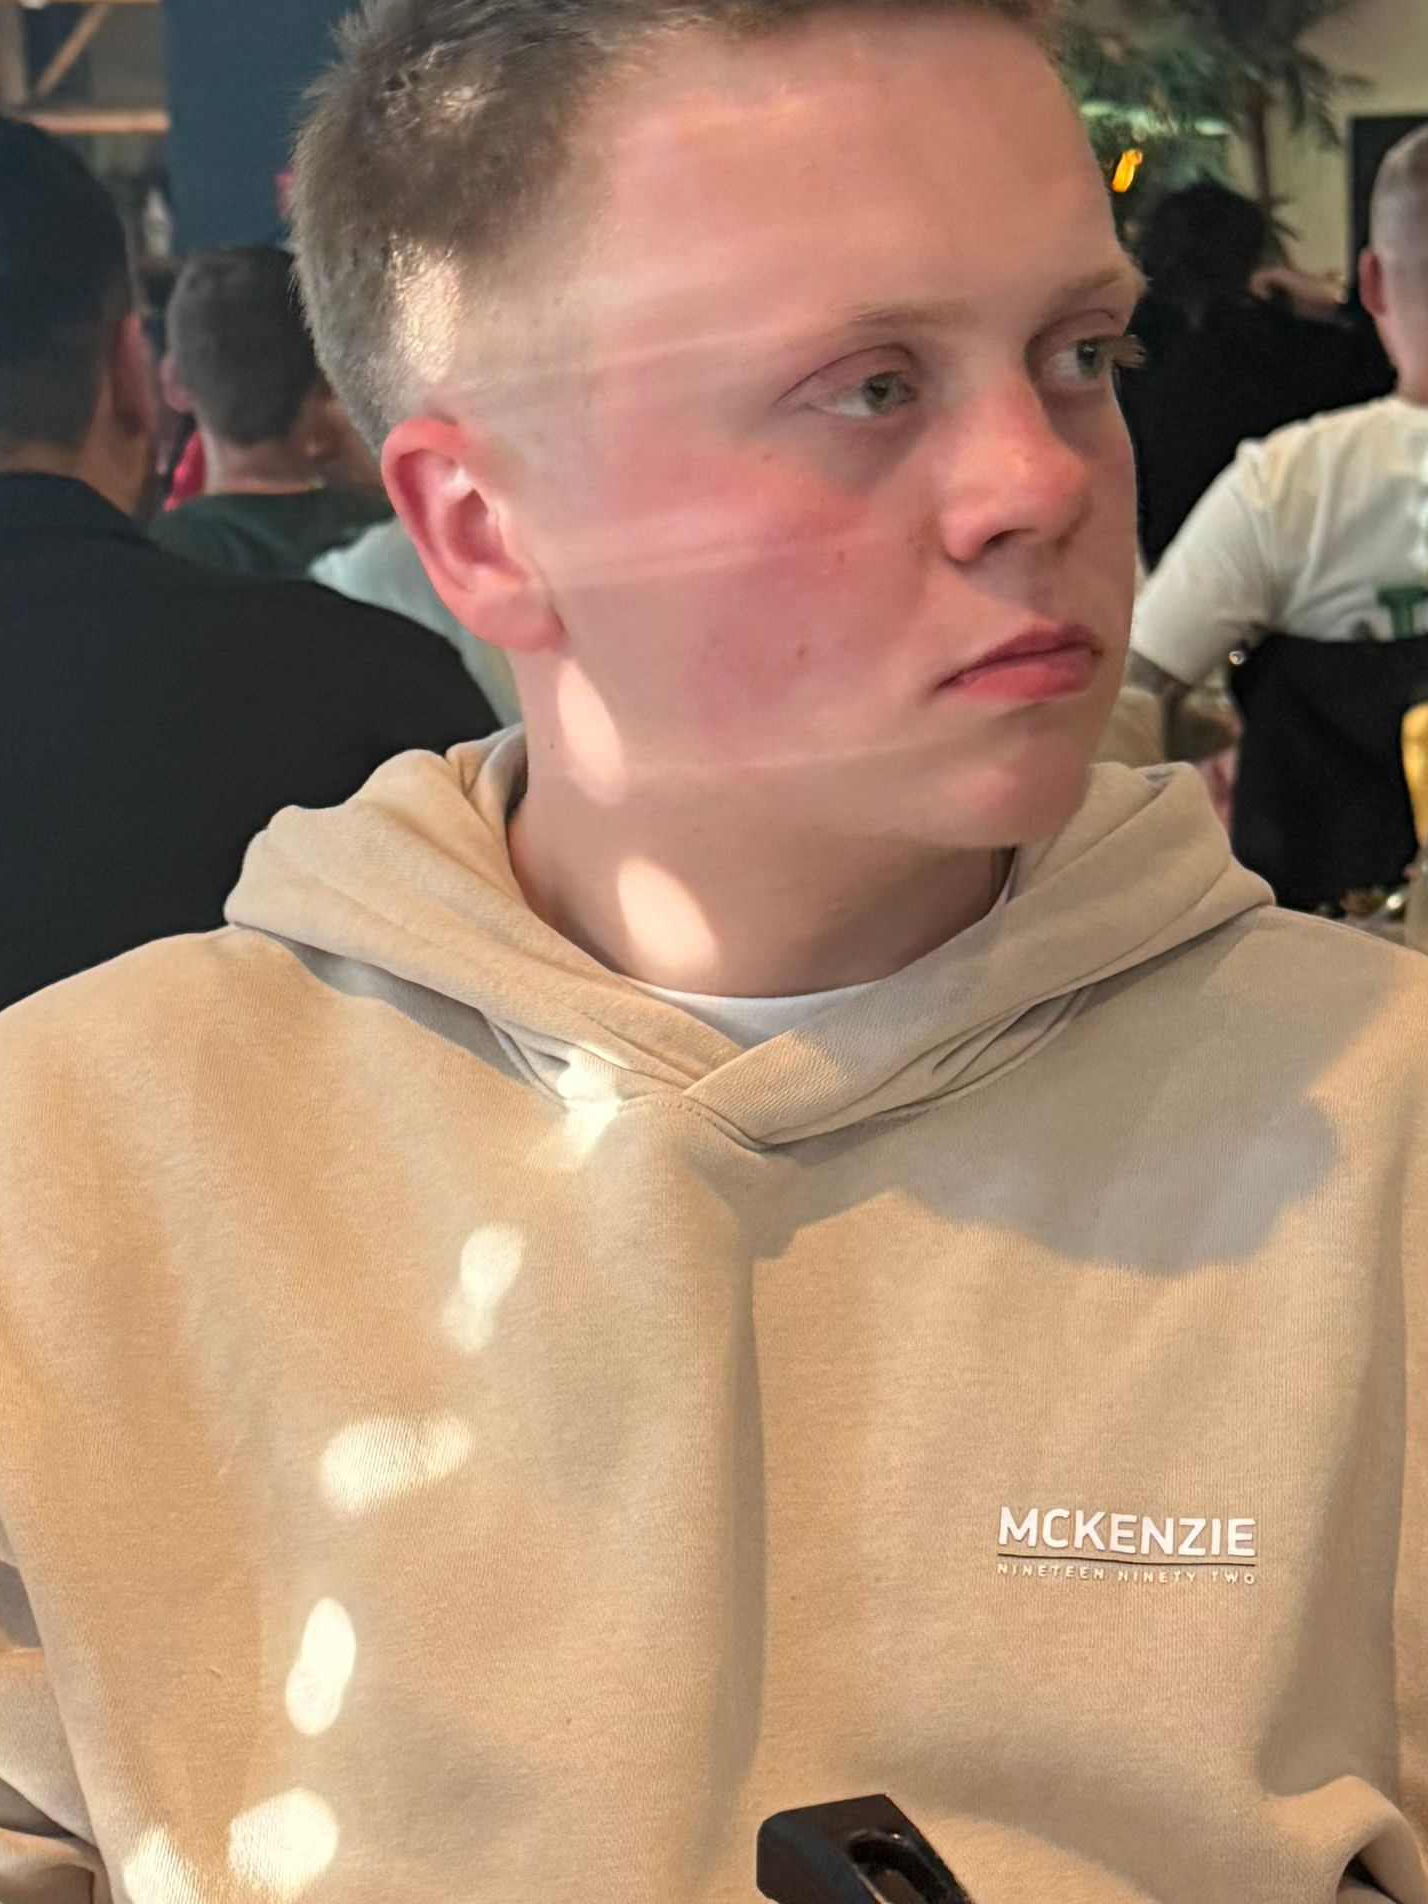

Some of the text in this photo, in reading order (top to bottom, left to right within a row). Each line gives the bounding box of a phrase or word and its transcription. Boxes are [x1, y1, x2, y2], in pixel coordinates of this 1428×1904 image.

[998, 1506, 1256, 1556] MCKENZIE
[997, 1563, 1255, 1585] NINETEEN NINETY TWO
